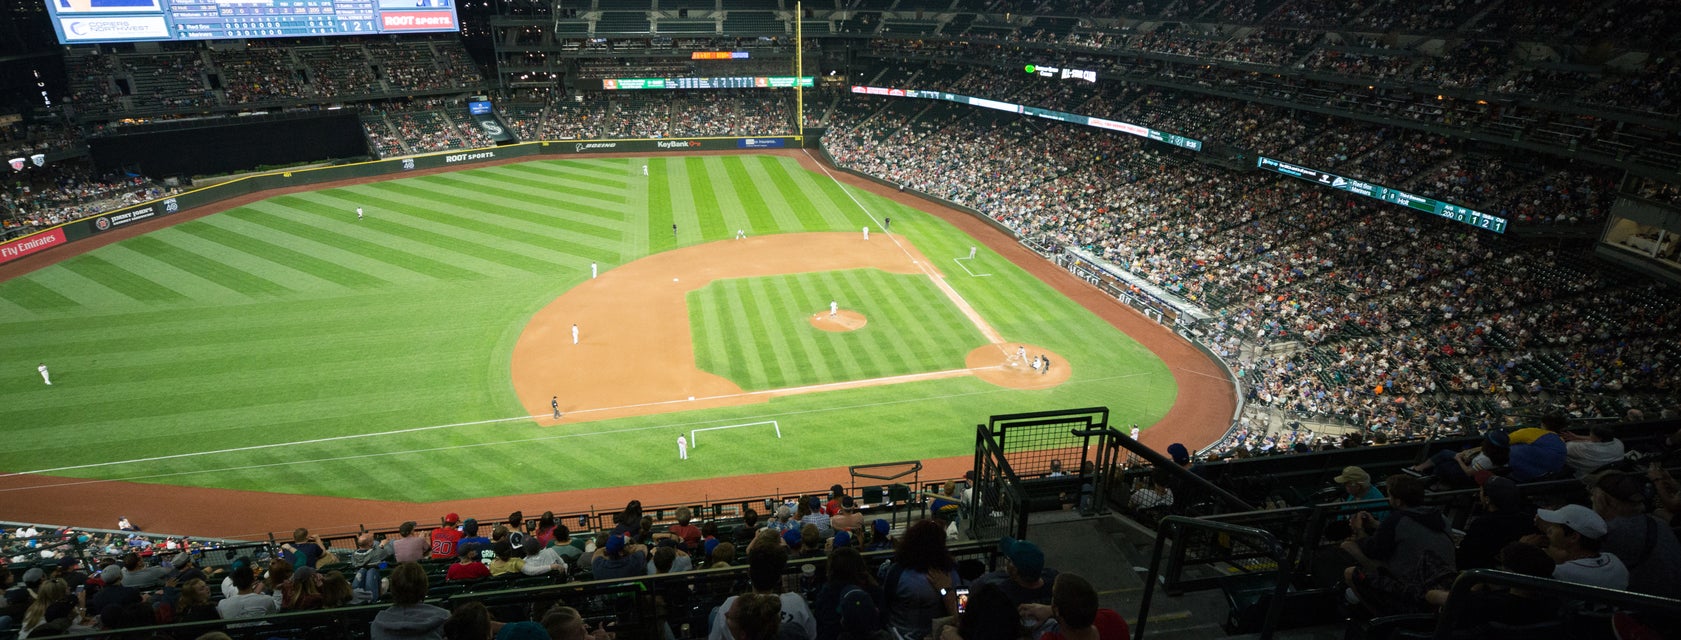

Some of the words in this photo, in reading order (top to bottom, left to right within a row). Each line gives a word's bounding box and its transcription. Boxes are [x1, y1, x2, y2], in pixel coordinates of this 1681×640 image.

[384, 16, 414, 25] ROOT
[342, 22, 347, 31] 1
[354, 21, 361, 31] 2
[367, 21, 372, 30] 1
[446, 154, 468, 162] ROOT
[1352, 187, 1371, 196] Mariners
[111, 213, 132, 222] JIMMY
[2, 246, 18, 257] Fly
[20, 234, 56, 251] Emirates
[432, 539, 452, 555] 20
